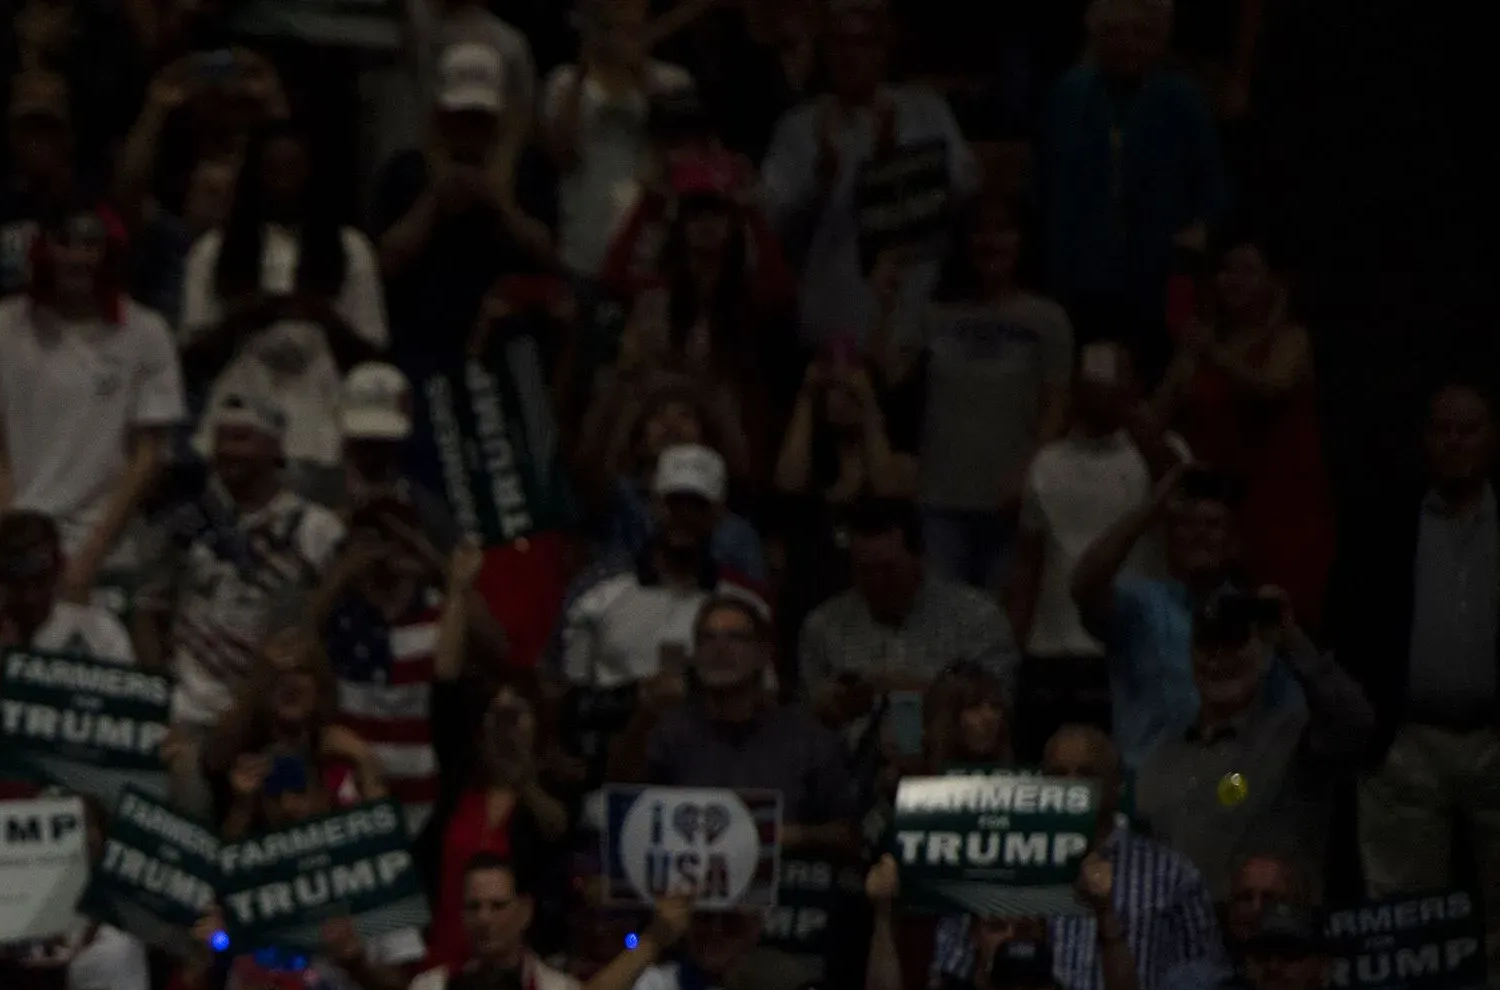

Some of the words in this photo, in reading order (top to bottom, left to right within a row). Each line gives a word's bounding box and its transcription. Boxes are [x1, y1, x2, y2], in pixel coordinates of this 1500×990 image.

[219, 803, 396, 875] FARMERS
[896, 830, 1088, 867] TRUMP
[226, 850, 414, 924] TRUMP
[1322, 936, 1479, 987] RUMP
